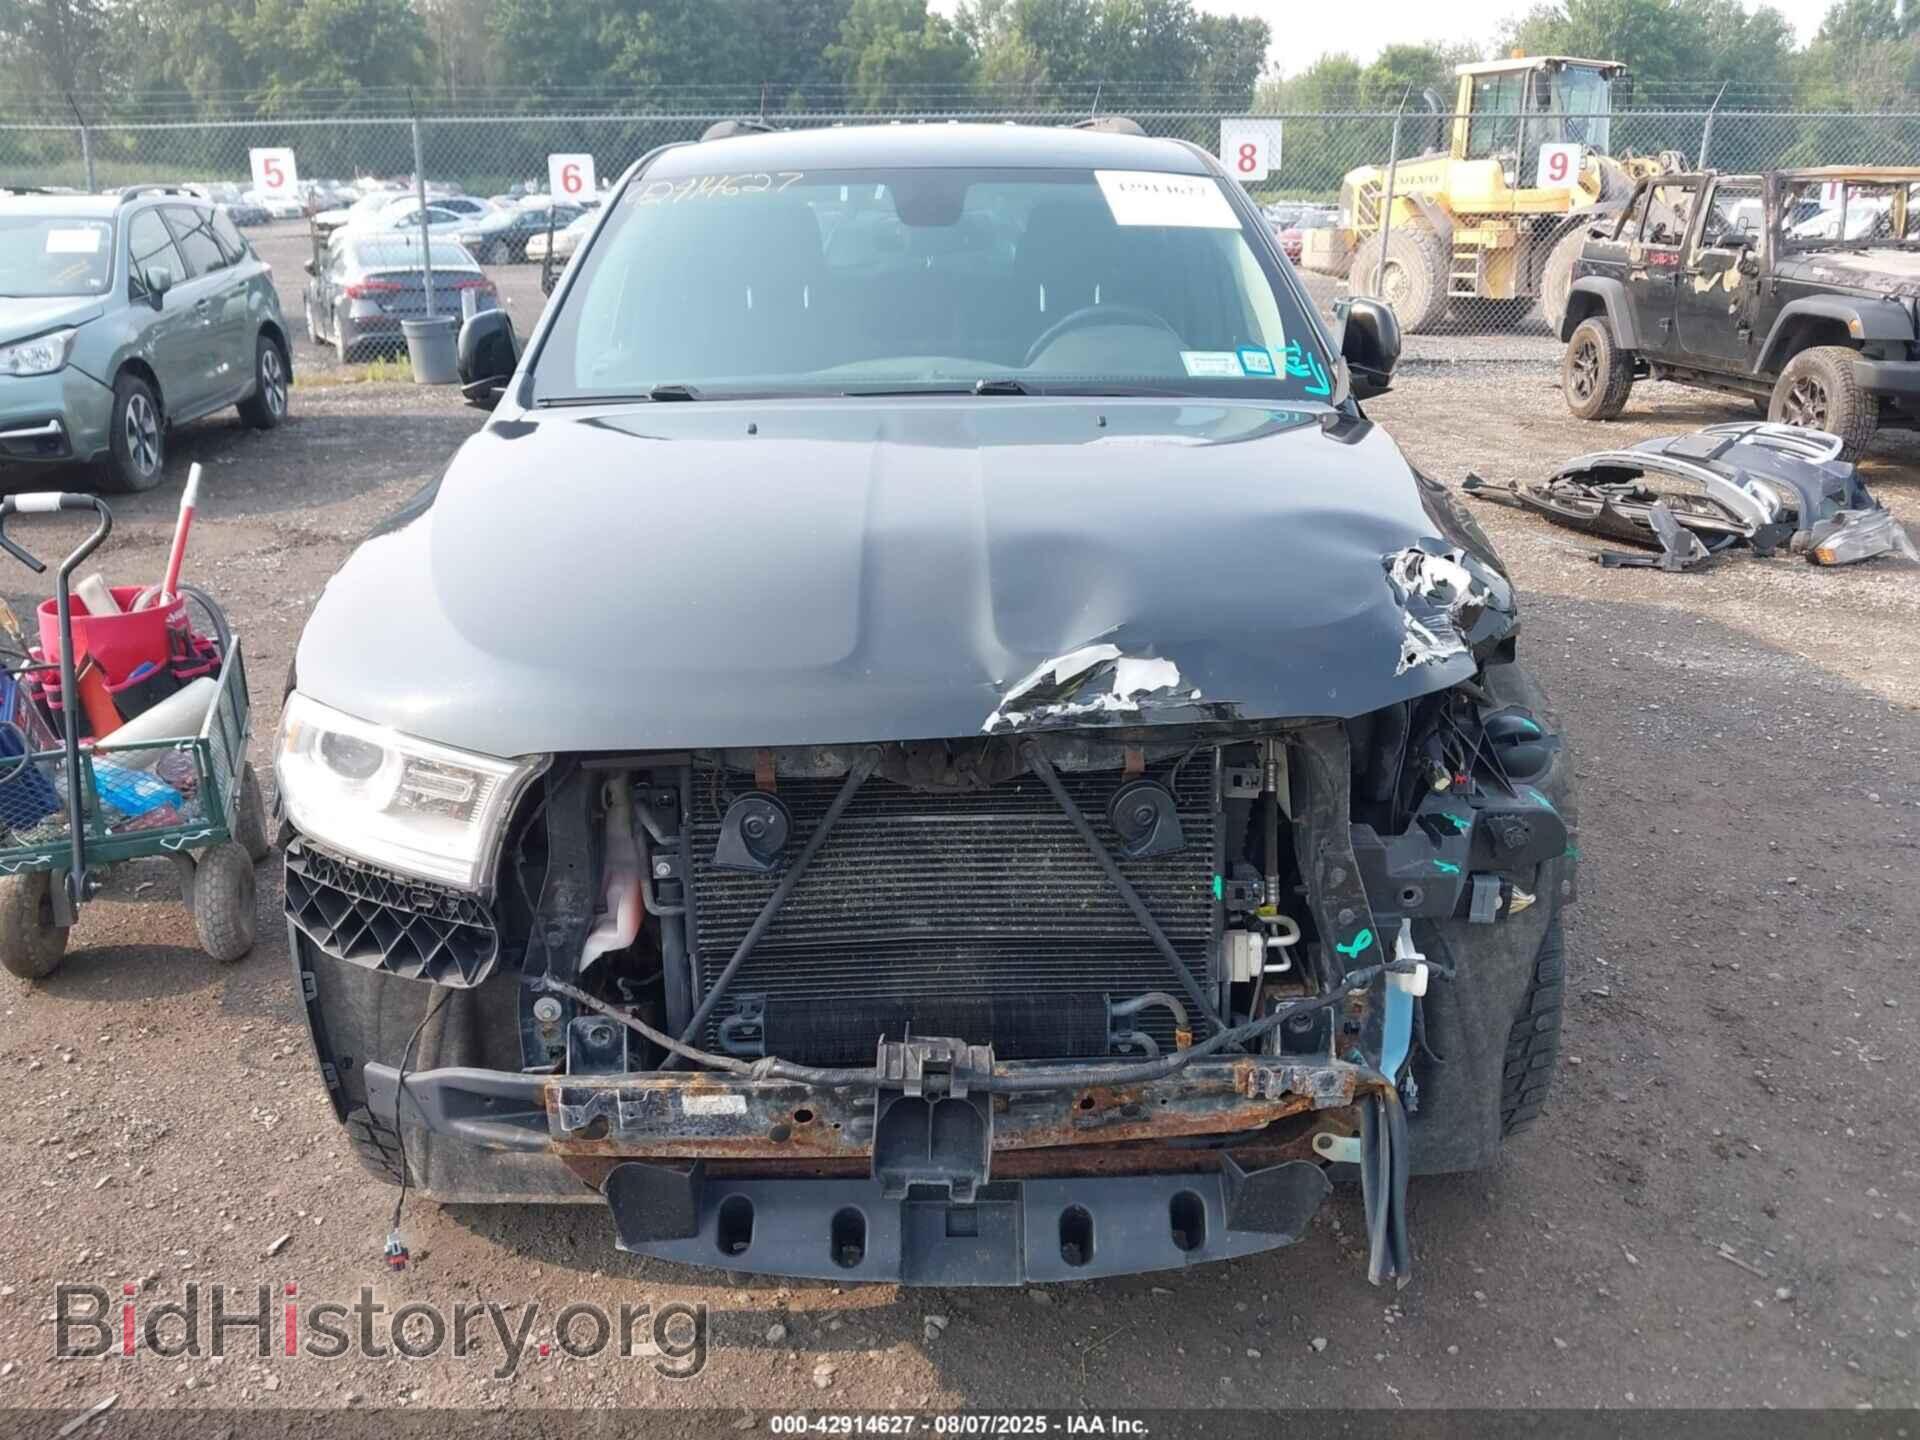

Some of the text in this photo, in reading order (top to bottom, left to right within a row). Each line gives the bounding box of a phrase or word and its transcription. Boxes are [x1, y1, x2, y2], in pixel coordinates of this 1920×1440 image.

[263, 158, 284, 188] 5
[1238, 143, 1257, 173] 8
[1549, 152, 1569, 181] 9
[562, 163, 582, 194] 6
